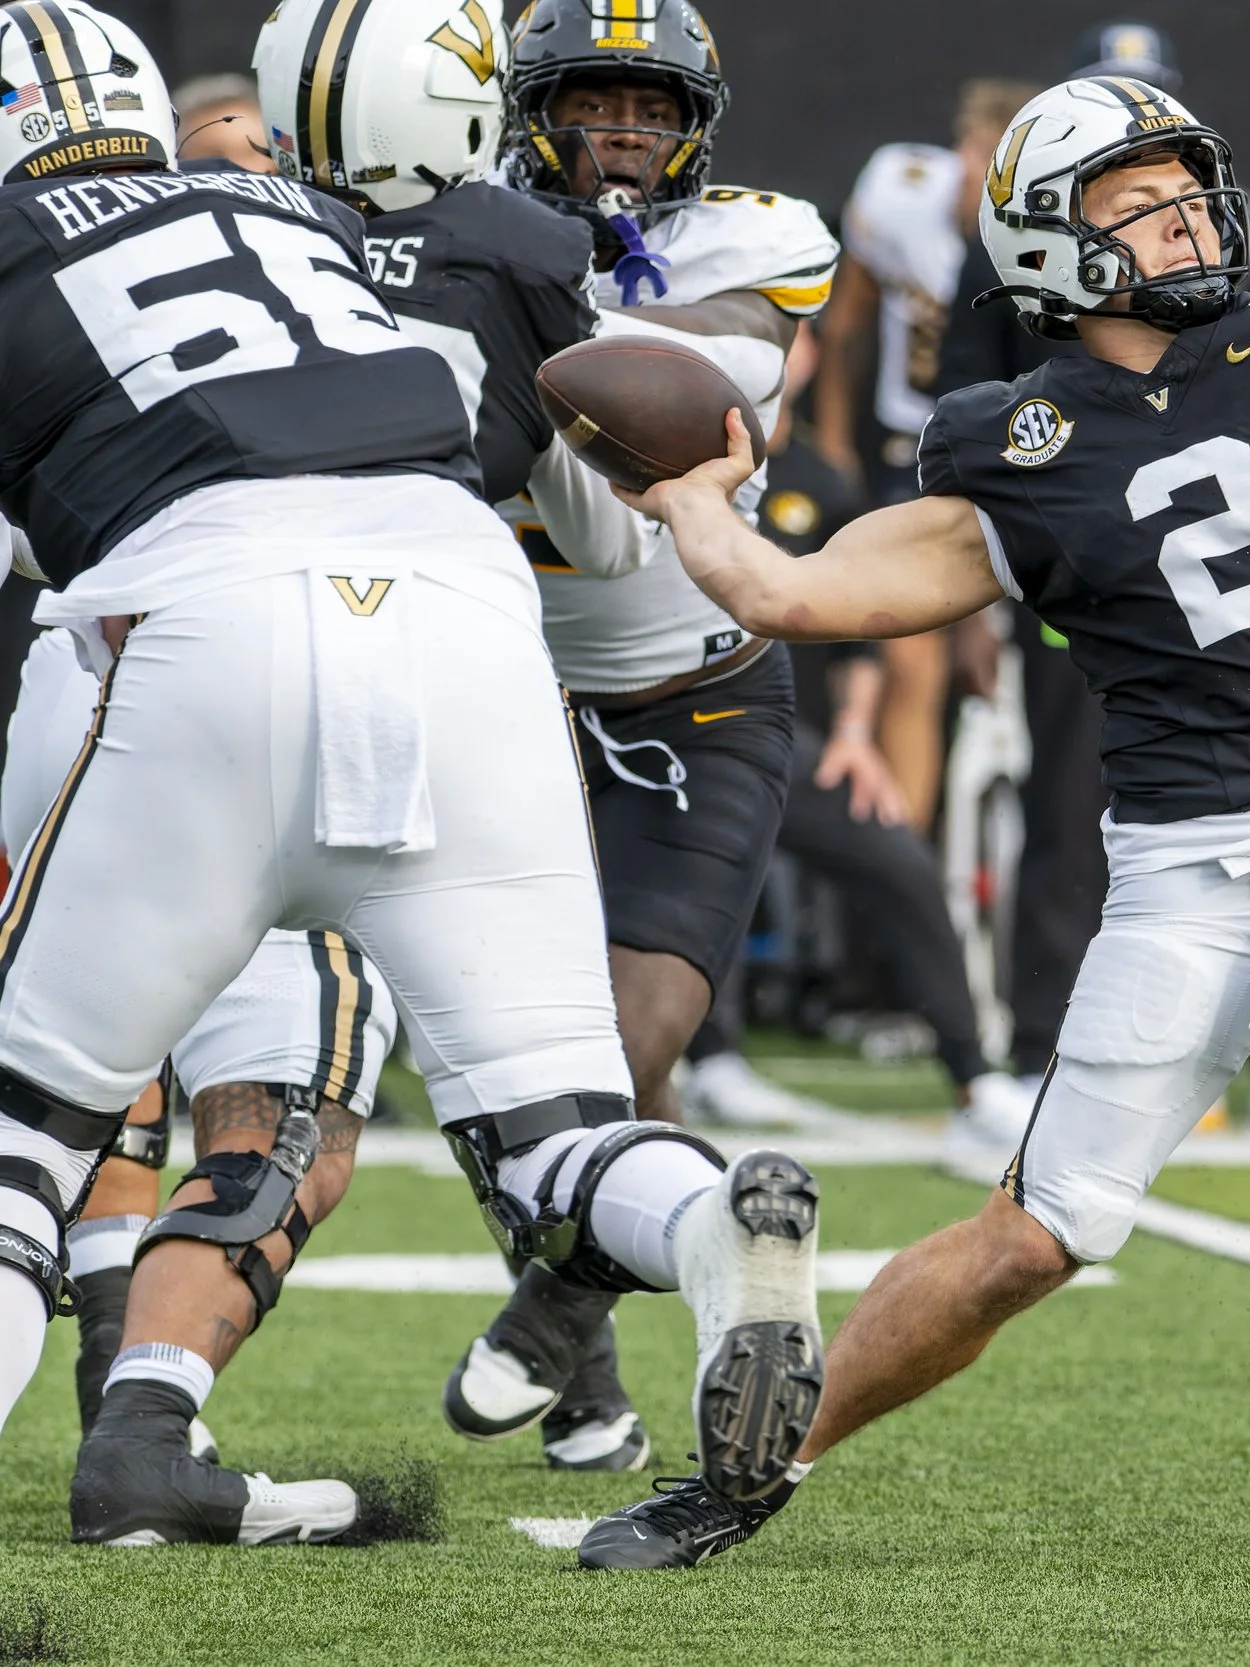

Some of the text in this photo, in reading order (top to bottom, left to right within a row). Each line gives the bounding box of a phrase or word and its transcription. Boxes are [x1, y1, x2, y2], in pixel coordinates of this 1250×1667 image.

[595, 38, 649, 50] MIZZOU
[21, 114, 50, 142] SEC
[52, 102, 100, 131] 5 5
[24, 137, 150, 179] VANDERBILT
[333, 172, 347, 188] 2
[35, 171, 322, 241] HENDERSON
[1012, 402, 1057, 451] SEC
[1012, 434, 1067, 465] GRADUATE
